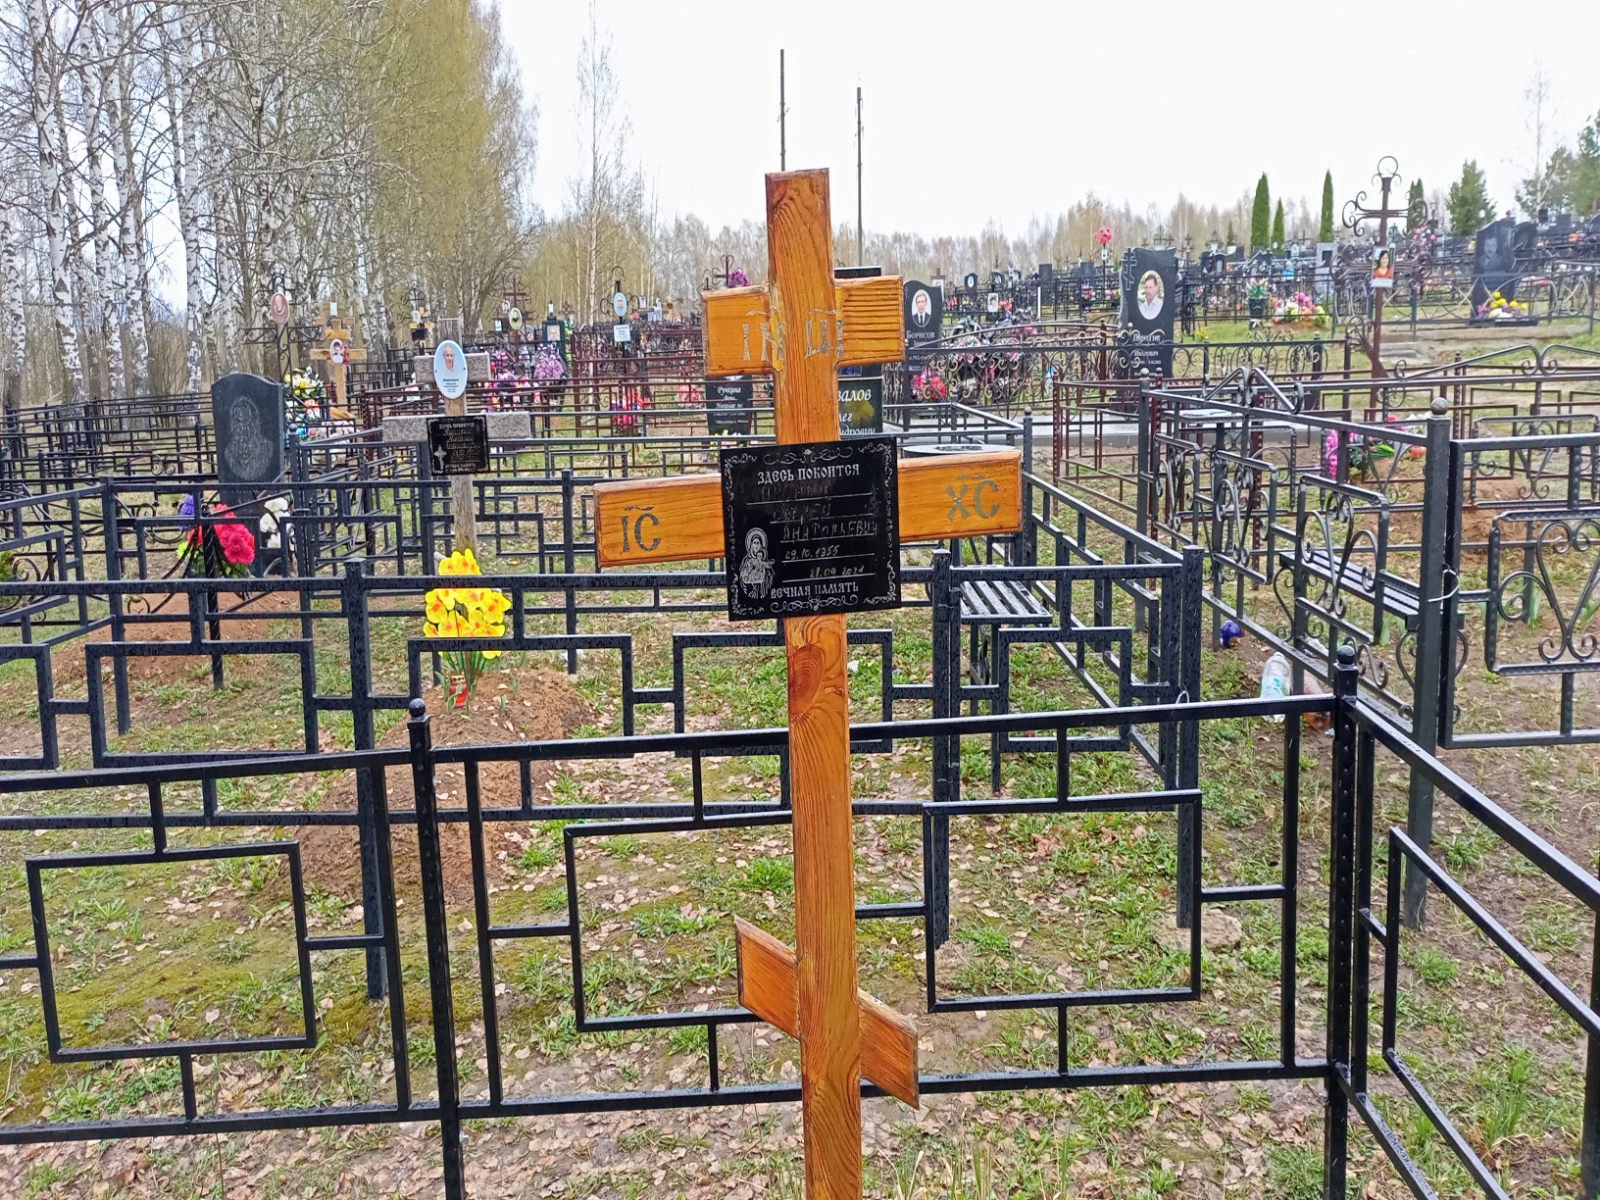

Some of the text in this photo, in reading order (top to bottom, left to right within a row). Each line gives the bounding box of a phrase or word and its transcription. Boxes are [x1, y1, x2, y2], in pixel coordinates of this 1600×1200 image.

[757, 463, 860, 485] ЗДЕСЬ ПОКОИТСЯ
[770, 581, 859, 599] ВЕЧНАЯ ПАМЯТЬ
